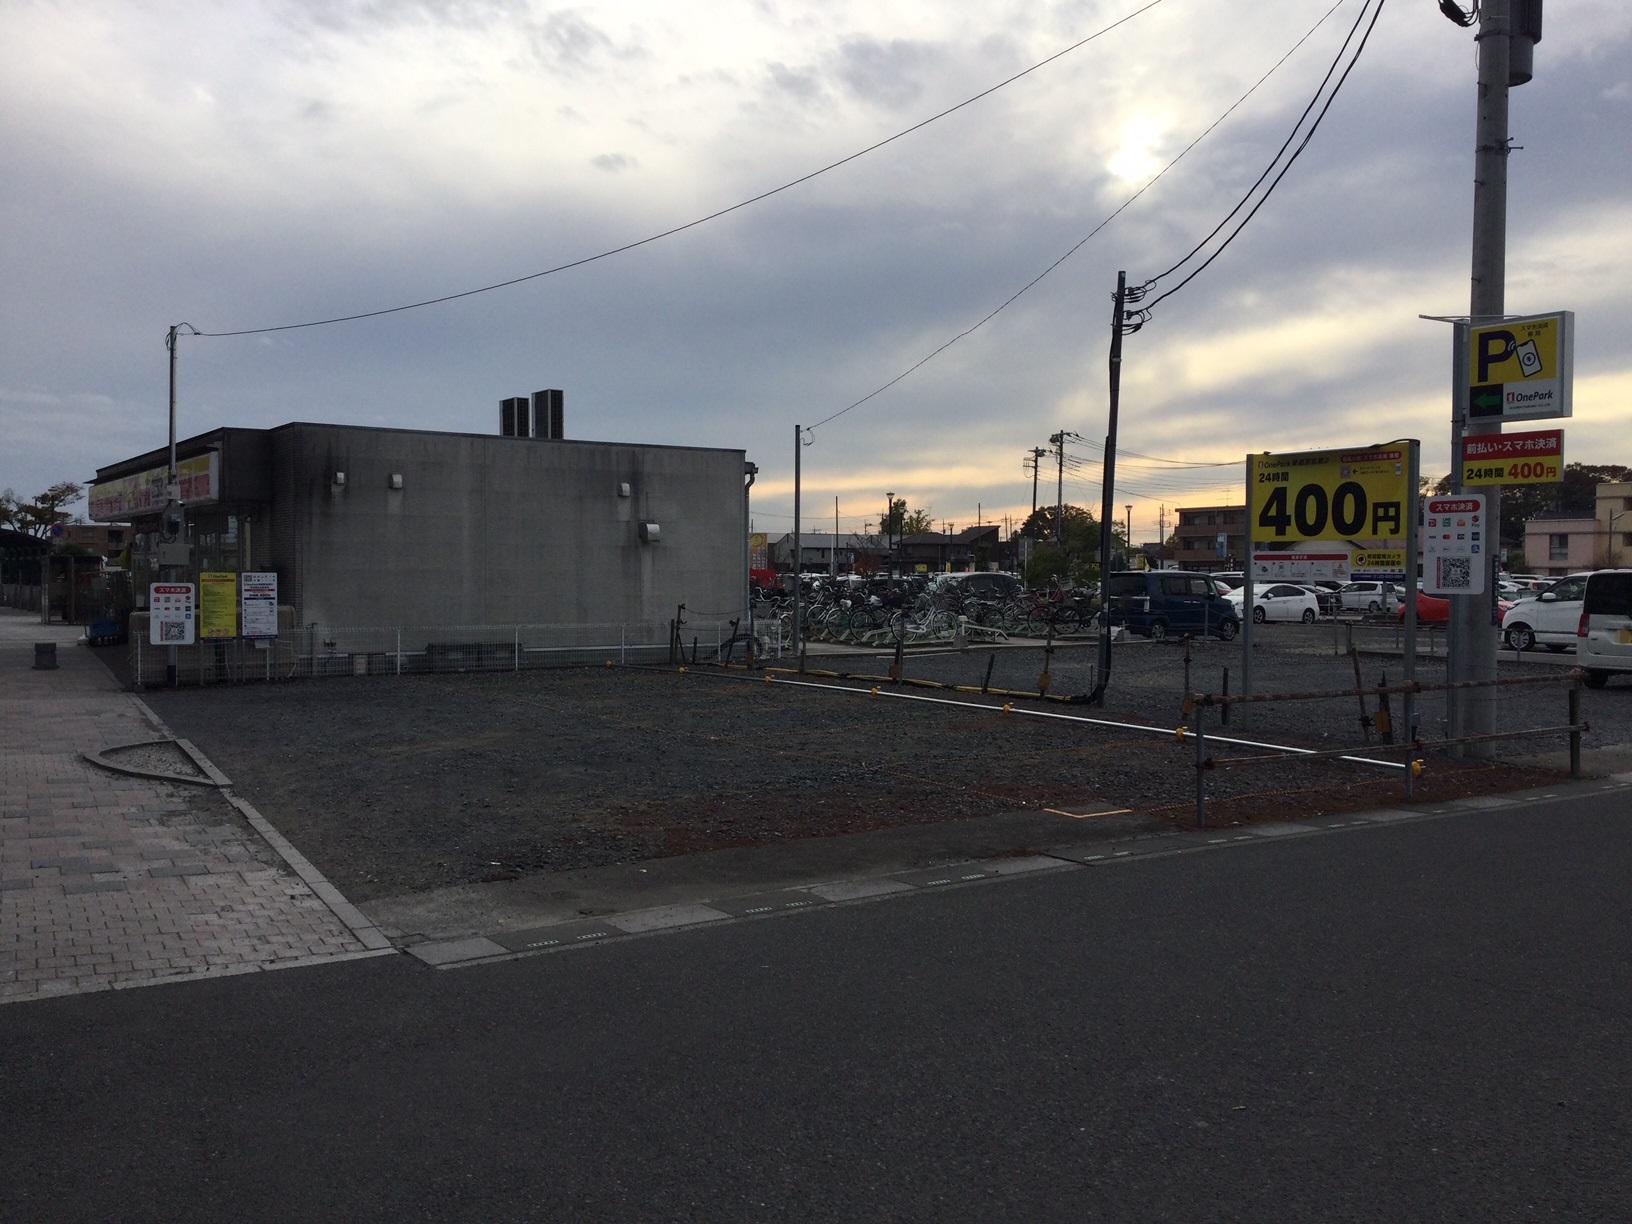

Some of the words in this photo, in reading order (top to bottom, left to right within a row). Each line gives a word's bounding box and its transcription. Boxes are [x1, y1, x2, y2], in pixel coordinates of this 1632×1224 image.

[1477, 329, 1516, 383] P
[1516, 390, 1553, 402] OnePark
[1258, 471, 1290, 483] 24時間
[1466, 467, 1505, 480] 24時間
[1508, 461, 1557, 479] 400円
[1258, 481, 1402, 537] 400円
[1435, 502, 1473, 511] スマホ決済
